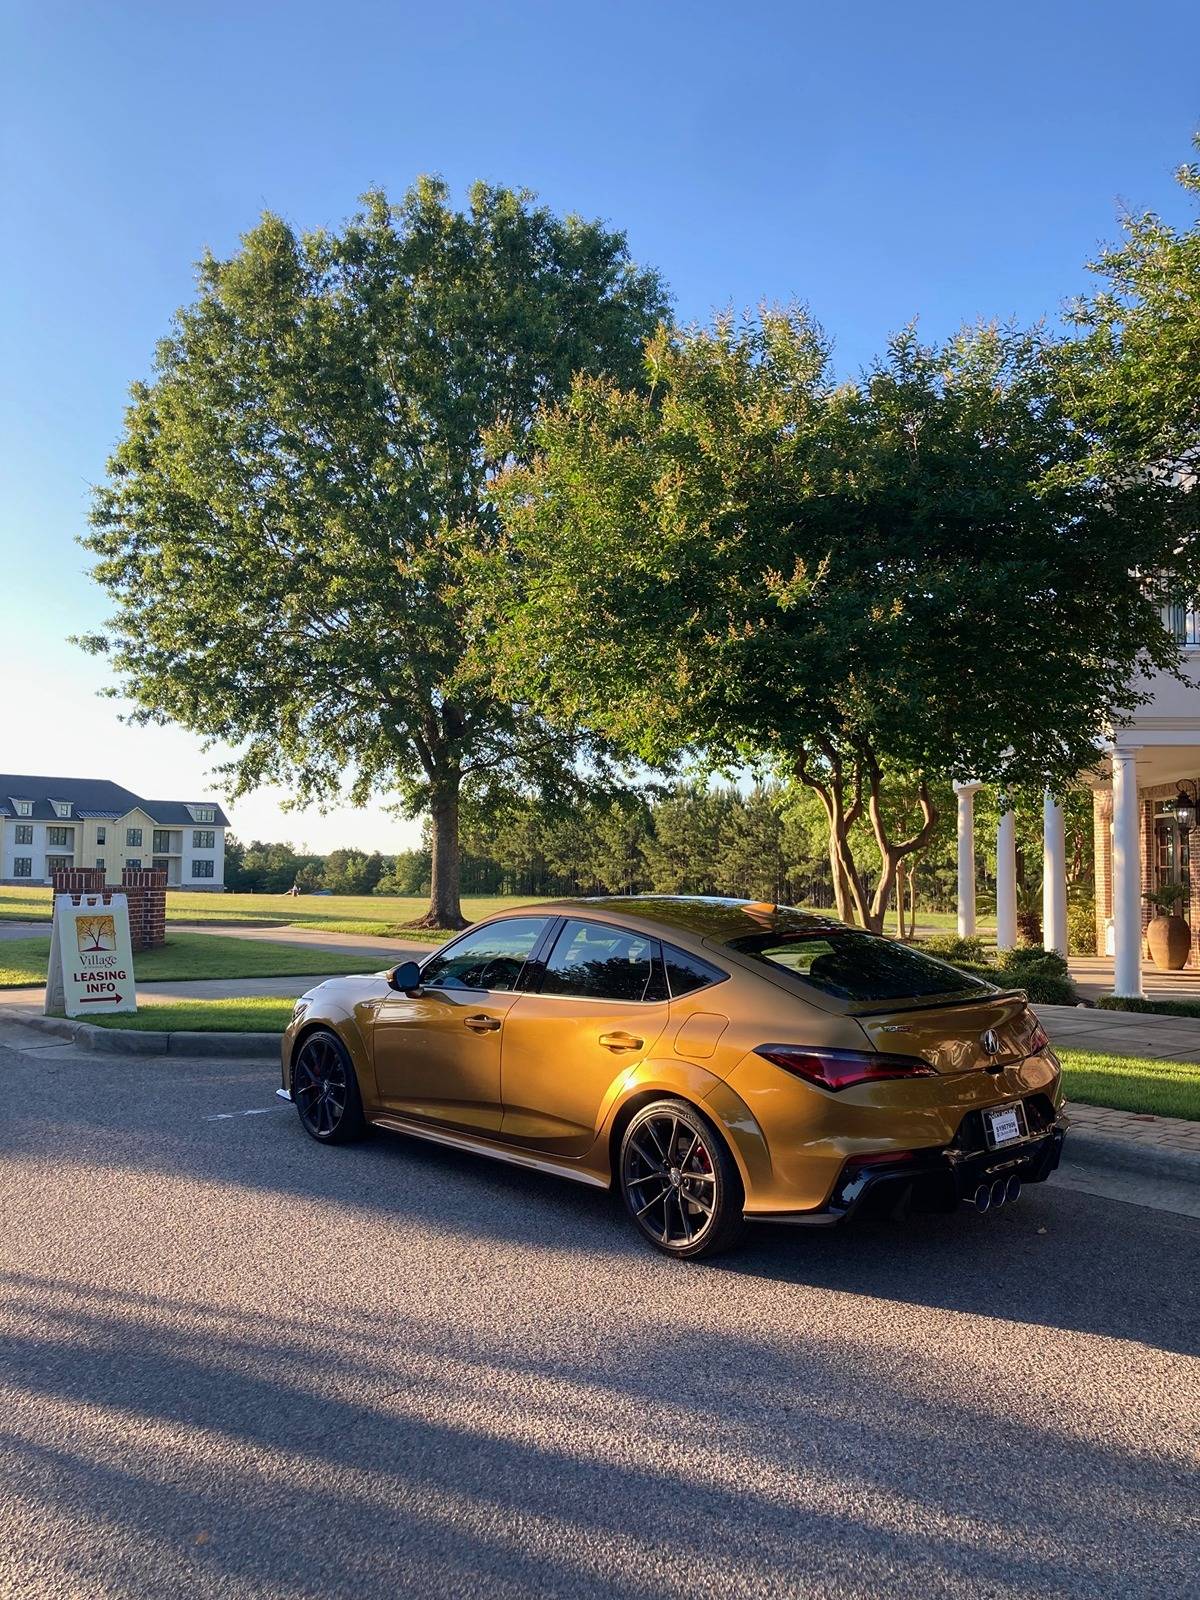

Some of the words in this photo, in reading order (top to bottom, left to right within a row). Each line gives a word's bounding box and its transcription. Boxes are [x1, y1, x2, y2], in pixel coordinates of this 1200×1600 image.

[80, 954, 117, 968] Village
[73, 970, 127, 982] LEASING
[86, 982, 116, 993] INFO
